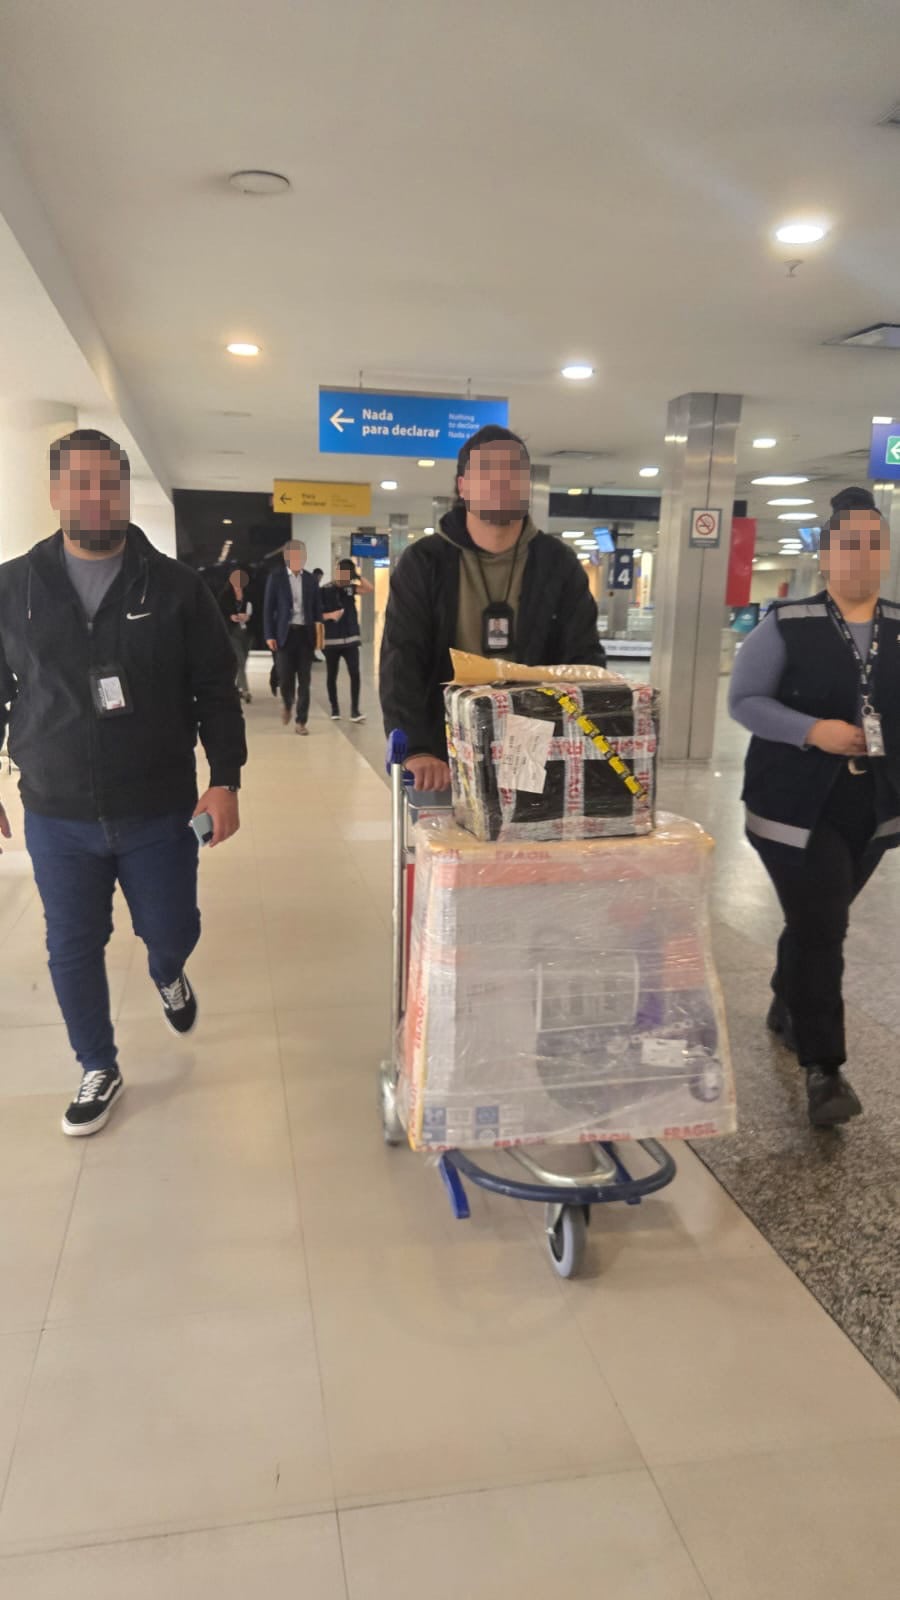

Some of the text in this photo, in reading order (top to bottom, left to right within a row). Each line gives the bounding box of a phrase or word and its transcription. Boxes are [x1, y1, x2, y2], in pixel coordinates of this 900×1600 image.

[362, 408, 394, 421] Nada
[448, 413, 475, 423] Nothing
[362, 423, 441, 438] para declarar
[617, 568, 630, 586] 4
